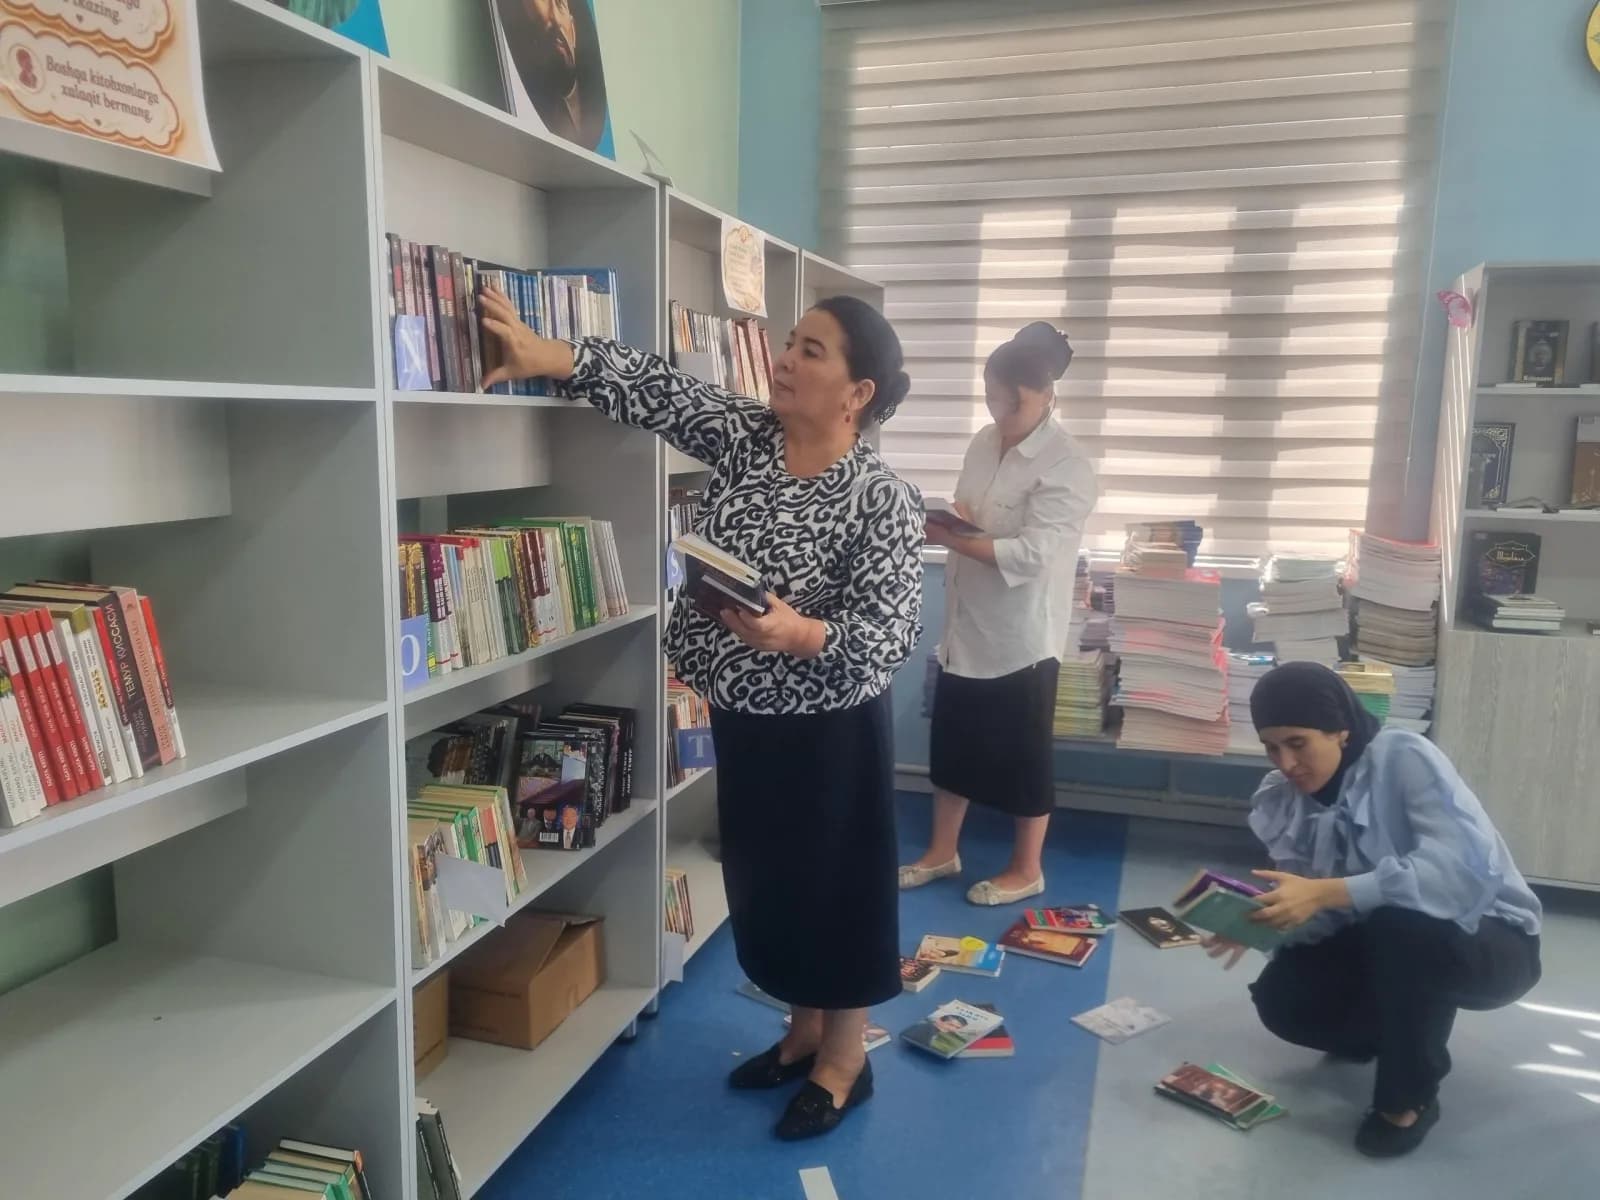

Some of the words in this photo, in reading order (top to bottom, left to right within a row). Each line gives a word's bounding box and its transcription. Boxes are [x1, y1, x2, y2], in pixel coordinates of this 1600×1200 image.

[46, 55, 87, 82] Boshqa
[89, 69, 160, 106] kitobxonlarga
[61, 84, 101, 109] xalaqit
[104, 604, 128, 660] КИССАСИ
[401, 634, 421, 677] O
[119, 662, 137, 698] ТЕМУР
[687, 735, 711, 760] T
